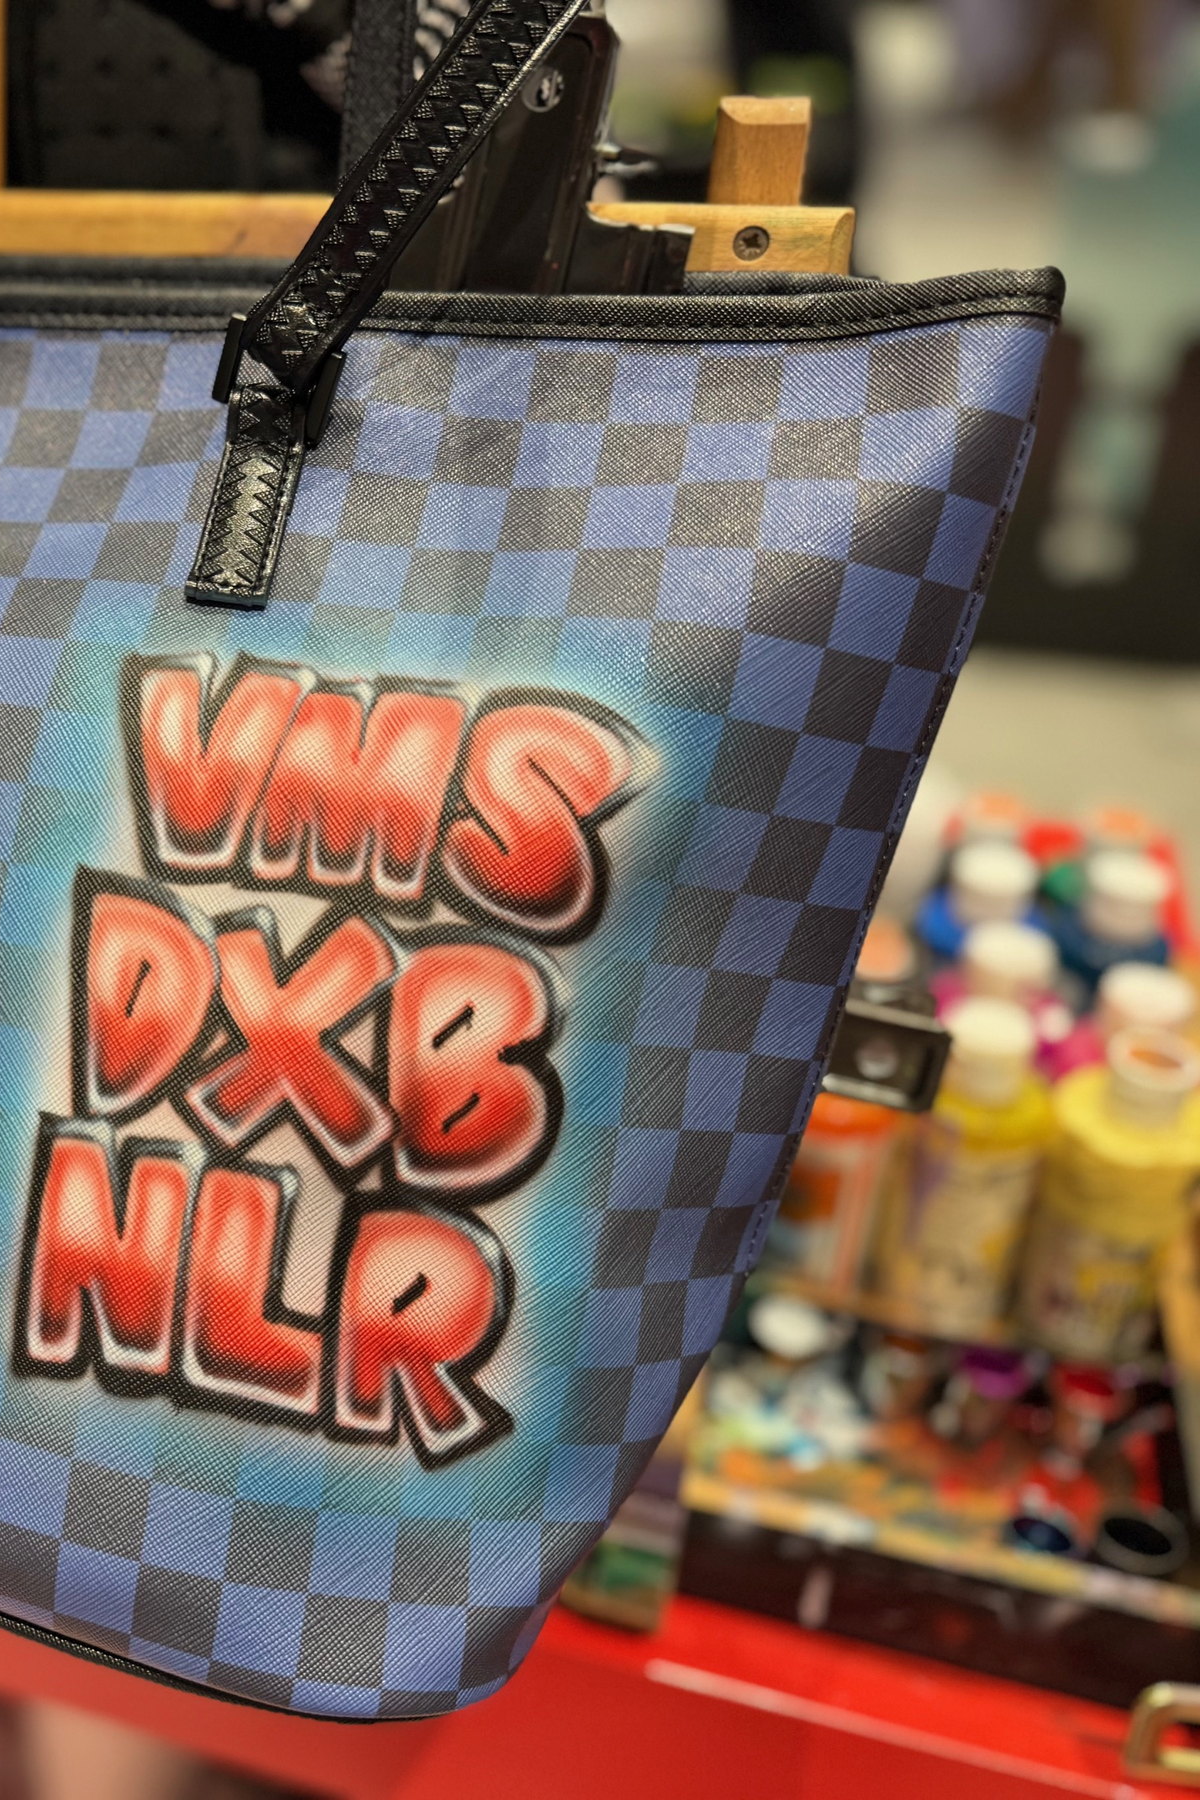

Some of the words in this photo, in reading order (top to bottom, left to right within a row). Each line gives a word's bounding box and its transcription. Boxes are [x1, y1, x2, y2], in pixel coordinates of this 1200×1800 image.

[120, 652, 652, 943] VMS
[72, 866, 564, 1202] DXB
[12, 1113, 514, 1470] NLR
